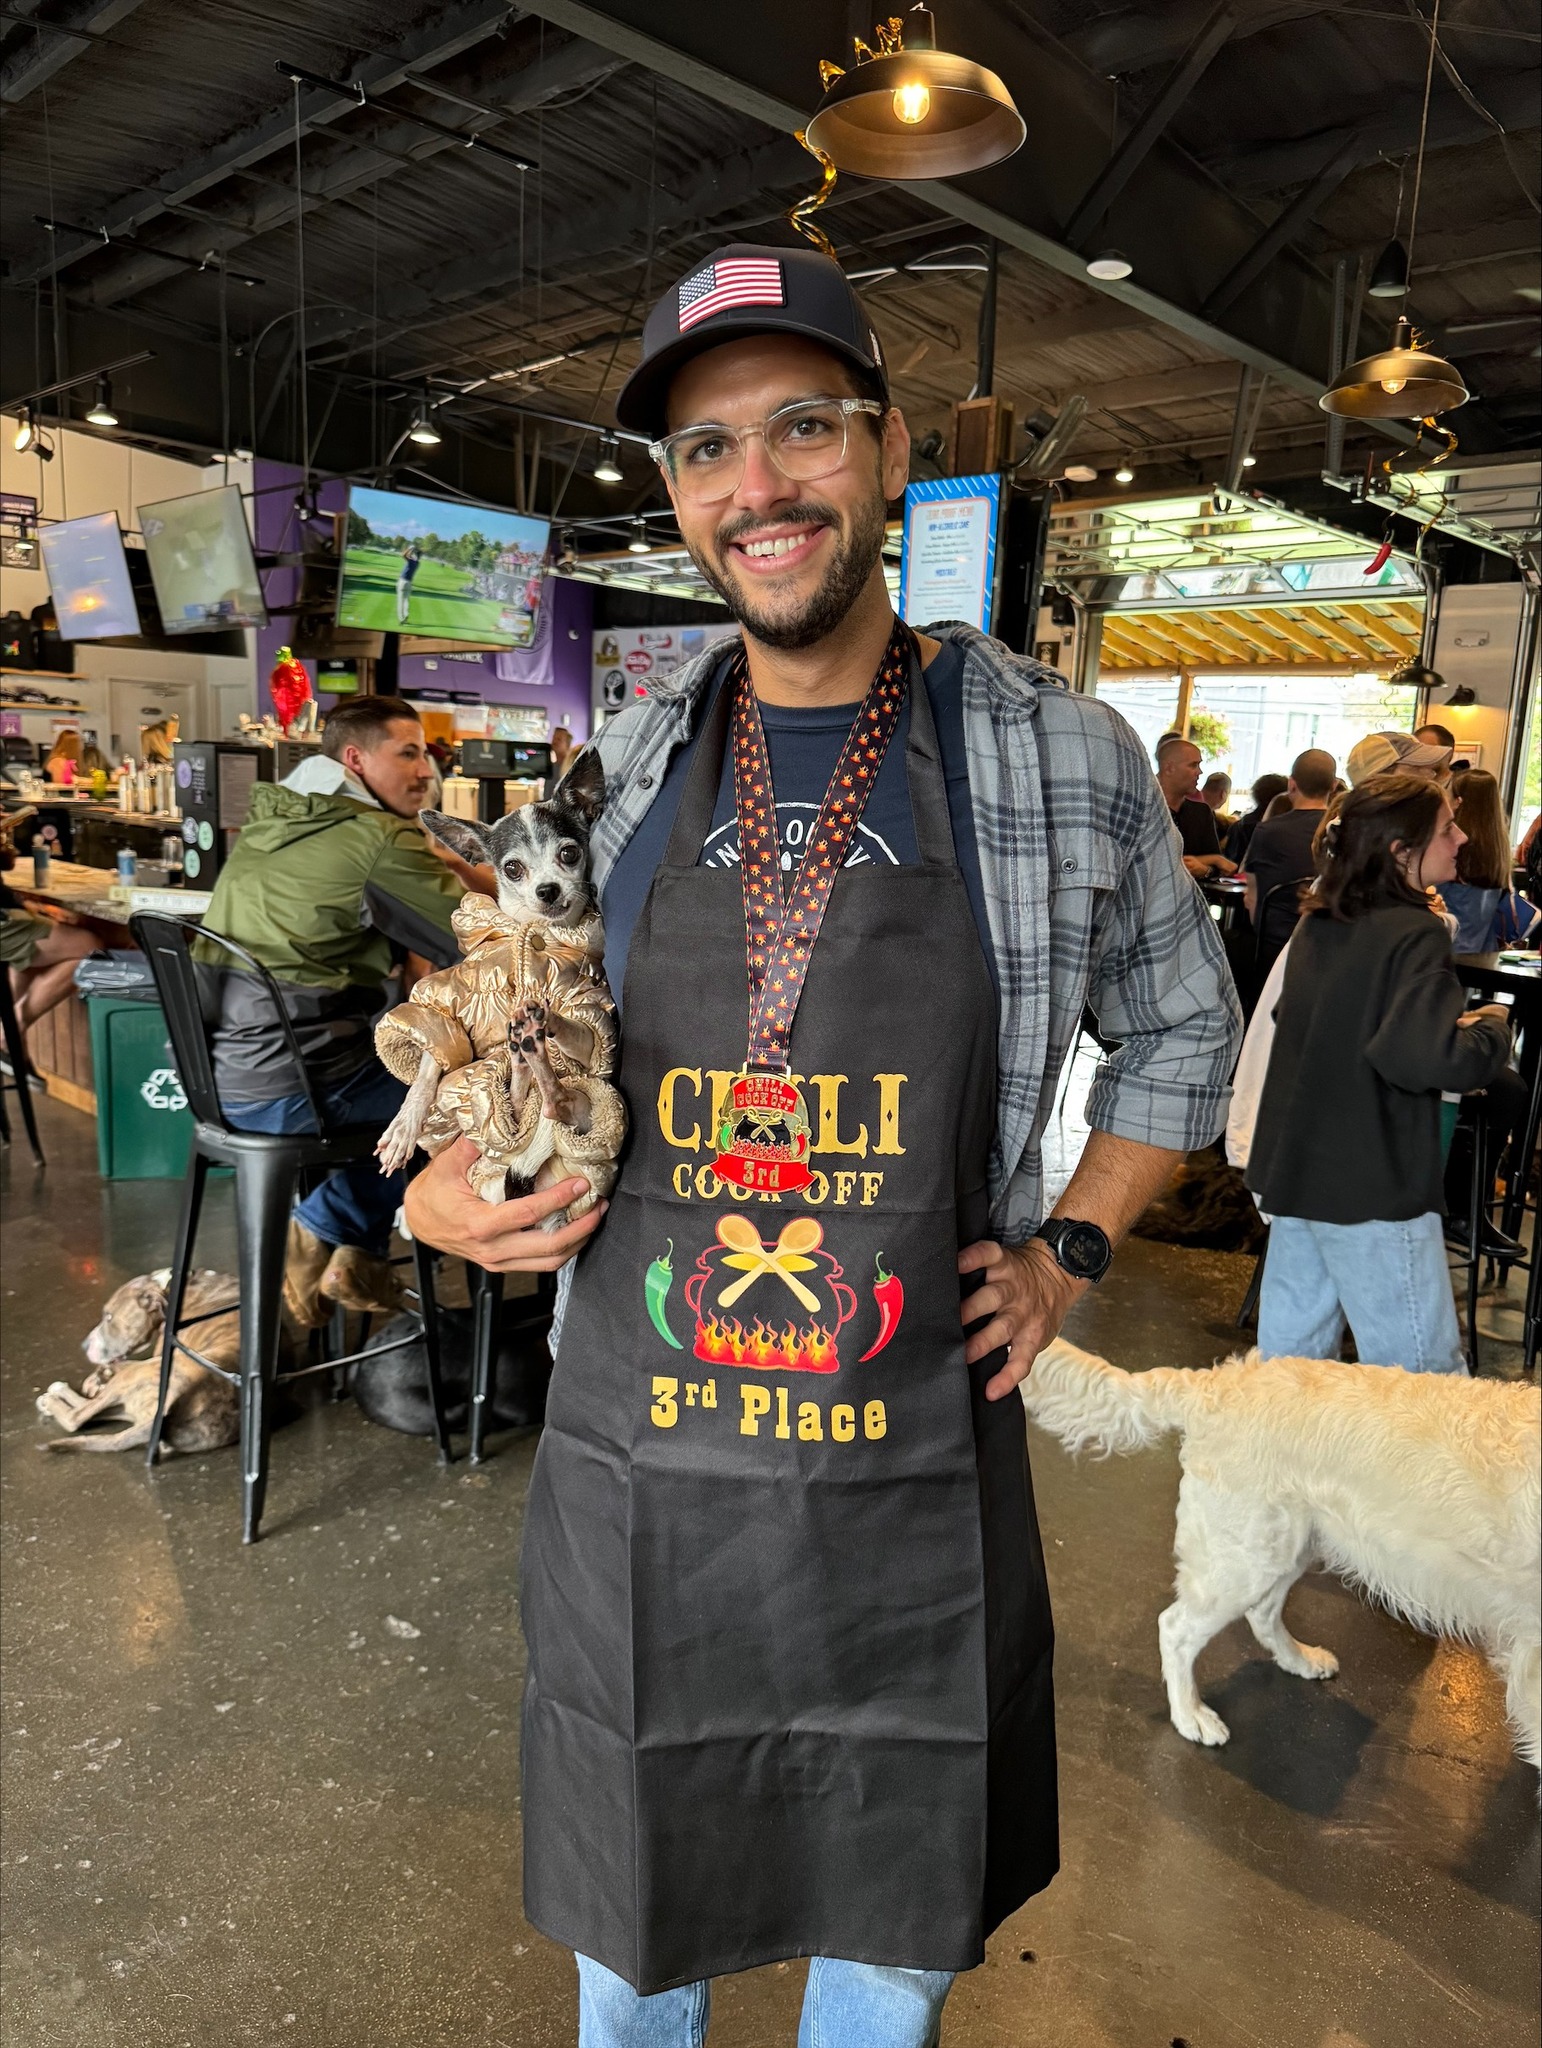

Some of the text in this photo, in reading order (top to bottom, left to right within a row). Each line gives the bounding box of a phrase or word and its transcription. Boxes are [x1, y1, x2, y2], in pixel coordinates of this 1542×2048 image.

[736, 1092, 795, 1111] COOK OFF
[745, 1078, 785, 1094] CHILI
[656, 1067, 907, 1160] CLI
[672, 1163, 884, 1206] CO OFF
[743, 1160, 780, 1188] 3rd
[650, 1376, 887, 1442] 3rd Place
